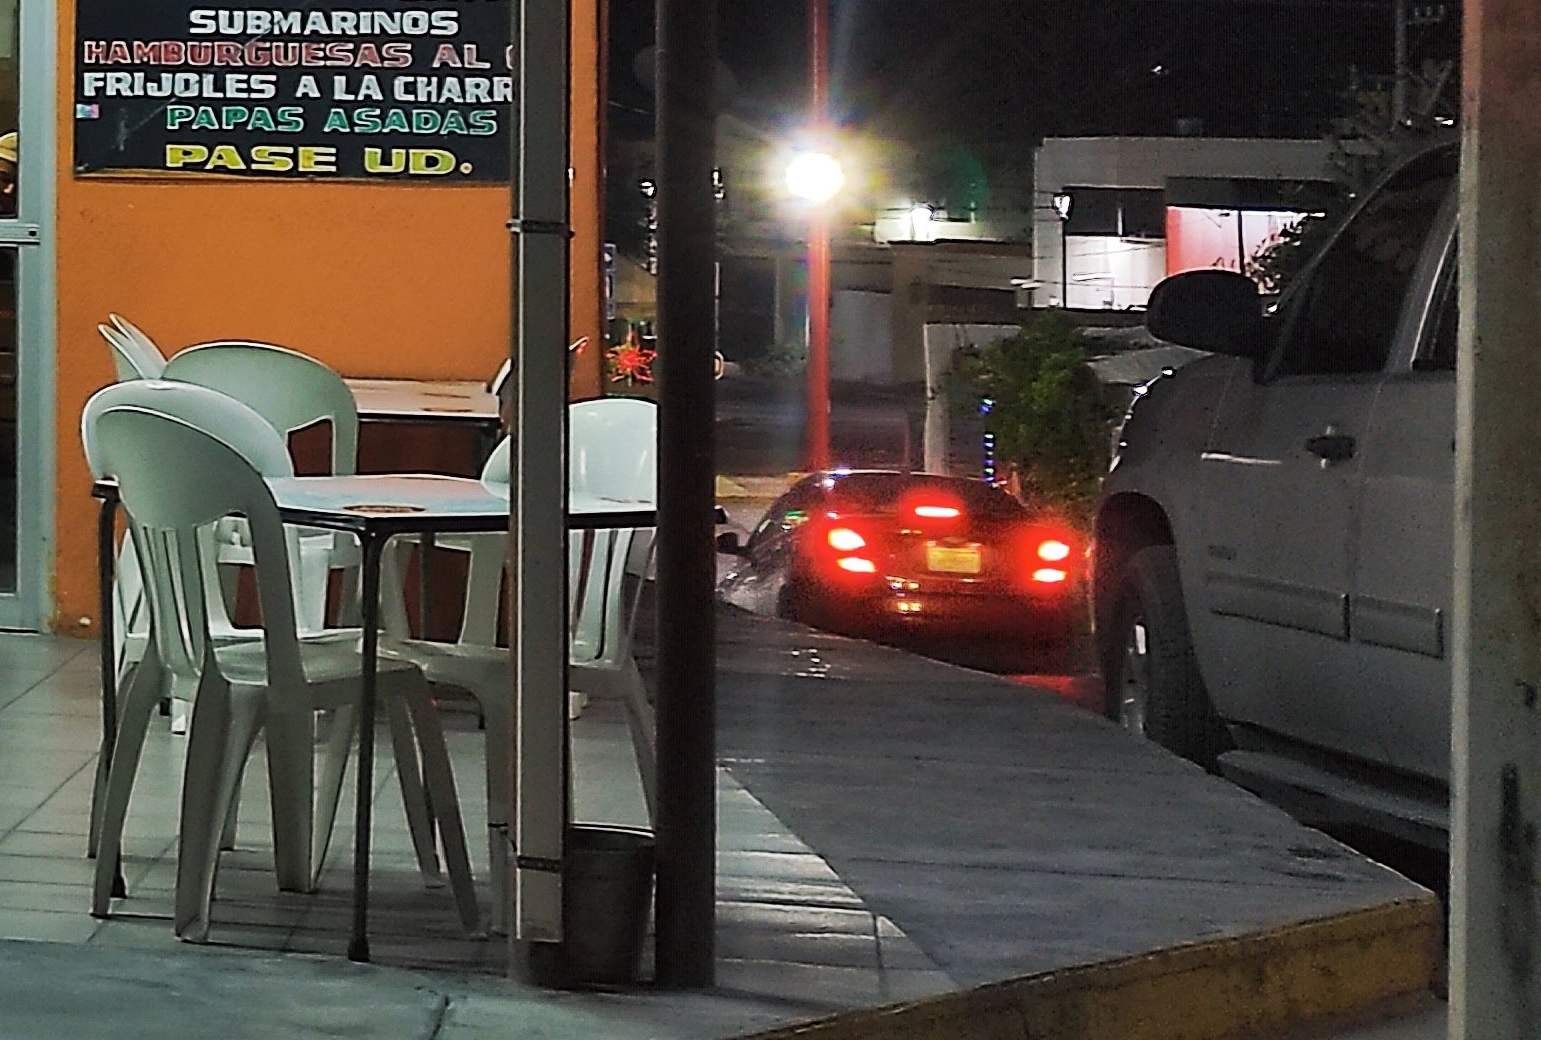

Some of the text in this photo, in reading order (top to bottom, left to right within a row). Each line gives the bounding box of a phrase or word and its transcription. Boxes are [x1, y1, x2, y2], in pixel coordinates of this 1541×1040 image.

[189, 9, 459, 36] SUBMARINOS
[83, 40, 413, 69] HAMBURGUESAS
[432, 43, 493, 69] AL
[83, 72, 514, 104] FRIJOLES A LA CHARR
[166, 103, 498, 135] PAPAS ASADAS
[165, 144, 473, 175] PASE UD.
